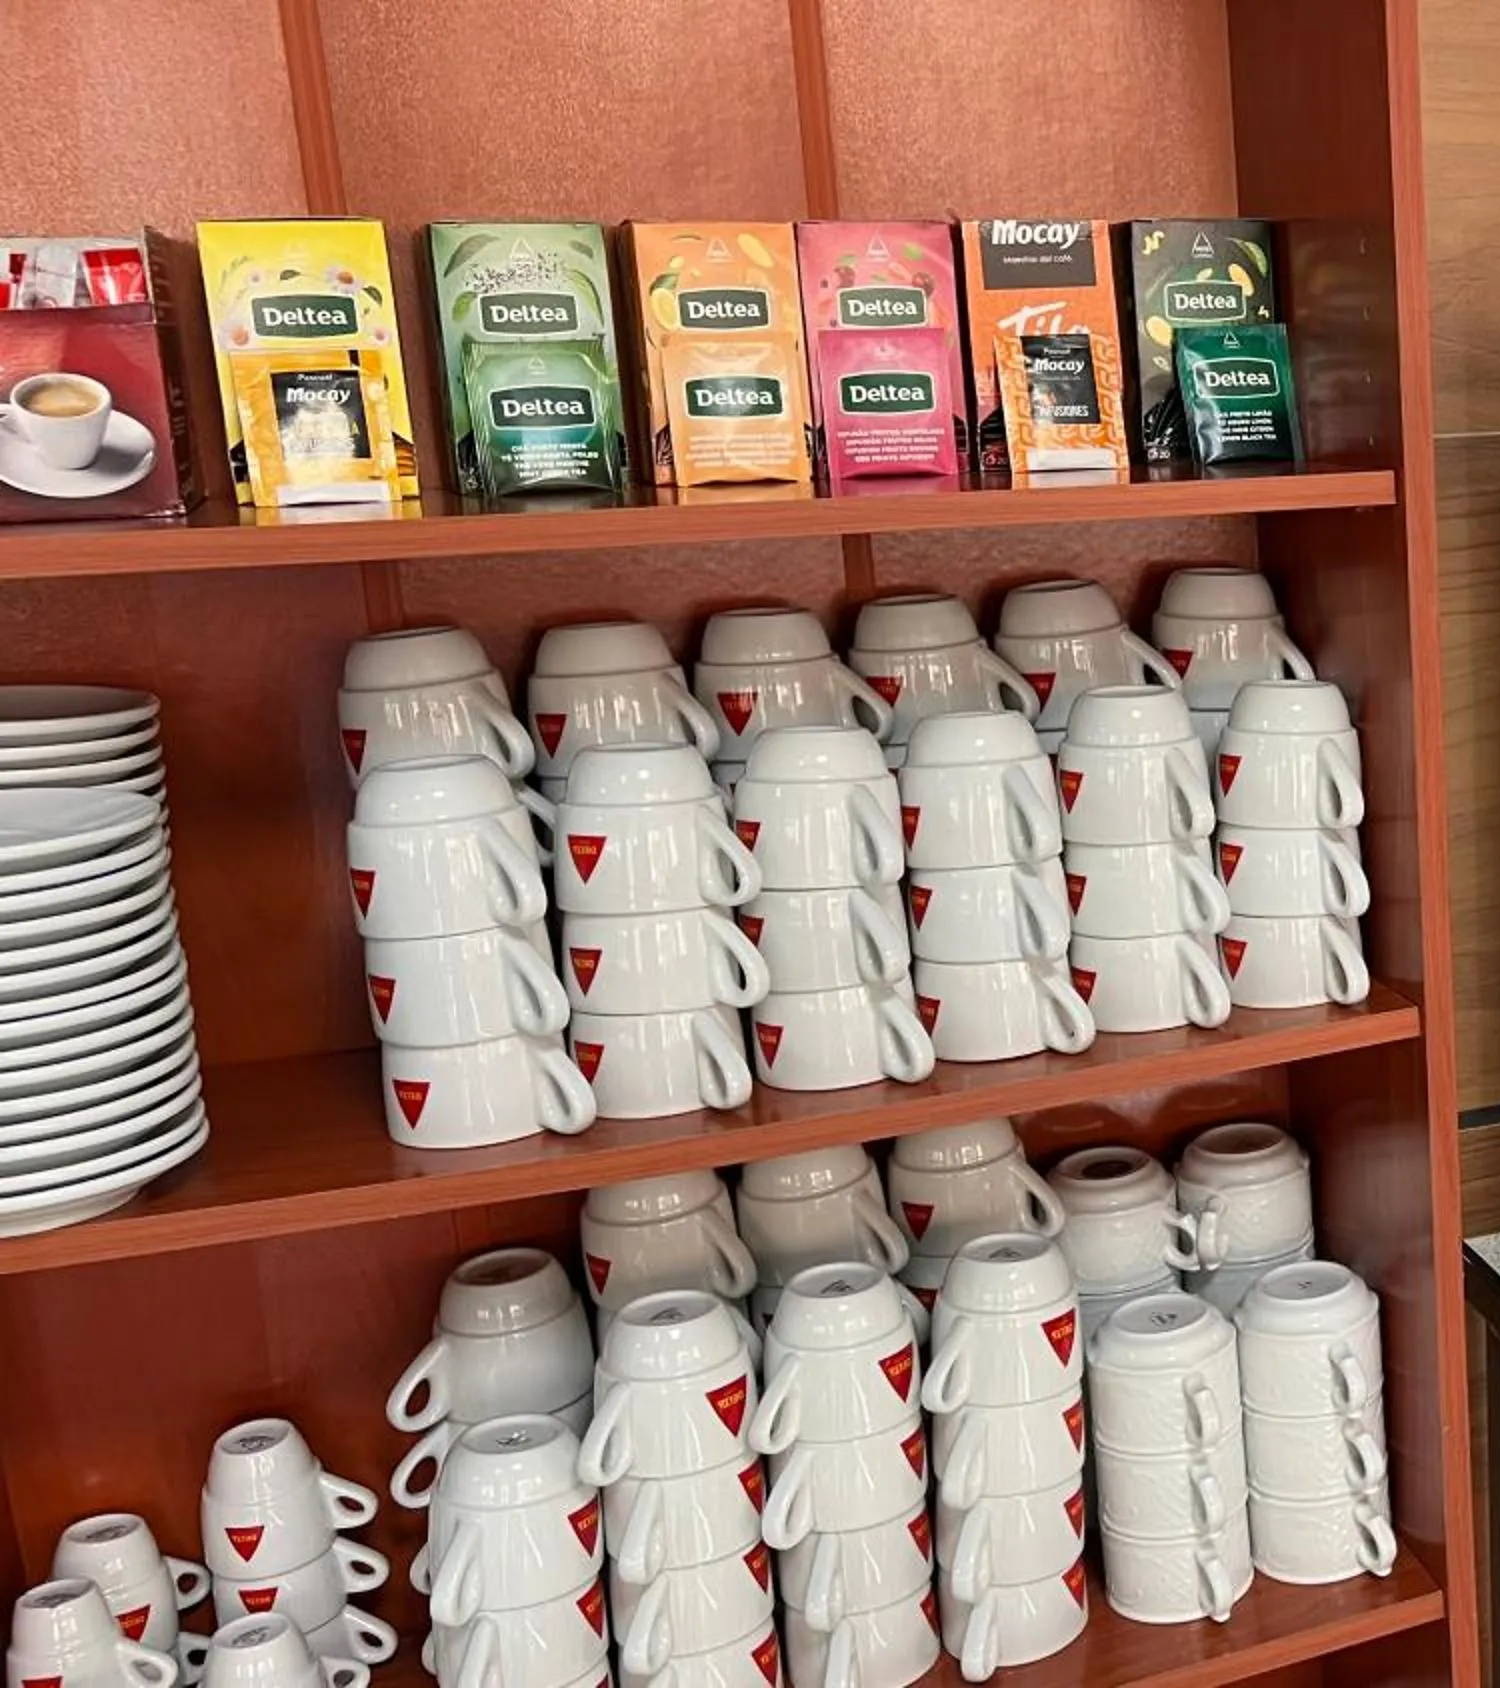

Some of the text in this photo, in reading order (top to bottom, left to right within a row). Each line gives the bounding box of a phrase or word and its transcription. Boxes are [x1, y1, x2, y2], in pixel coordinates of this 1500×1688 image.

[991, 219, 1080, 250] Mocay
[687, 300, 761, 319] Deltea
[847, 298, 918, 317] Deltea
[1174, 292, 1238, 310] Deltea
[262, 306, 348, 327] Deltea
[489, 304, 569, 323] Deltea
[1033, 358, 1085, 375] Mocay
[1203, 370, 1271, 387] Deltea
[286, 387, 351, 405] Mocay
[694, 387, 775, 407] Deltea
[849, 384, 925, 403] Deltea
[501, 398, 586, 418] Deltea
